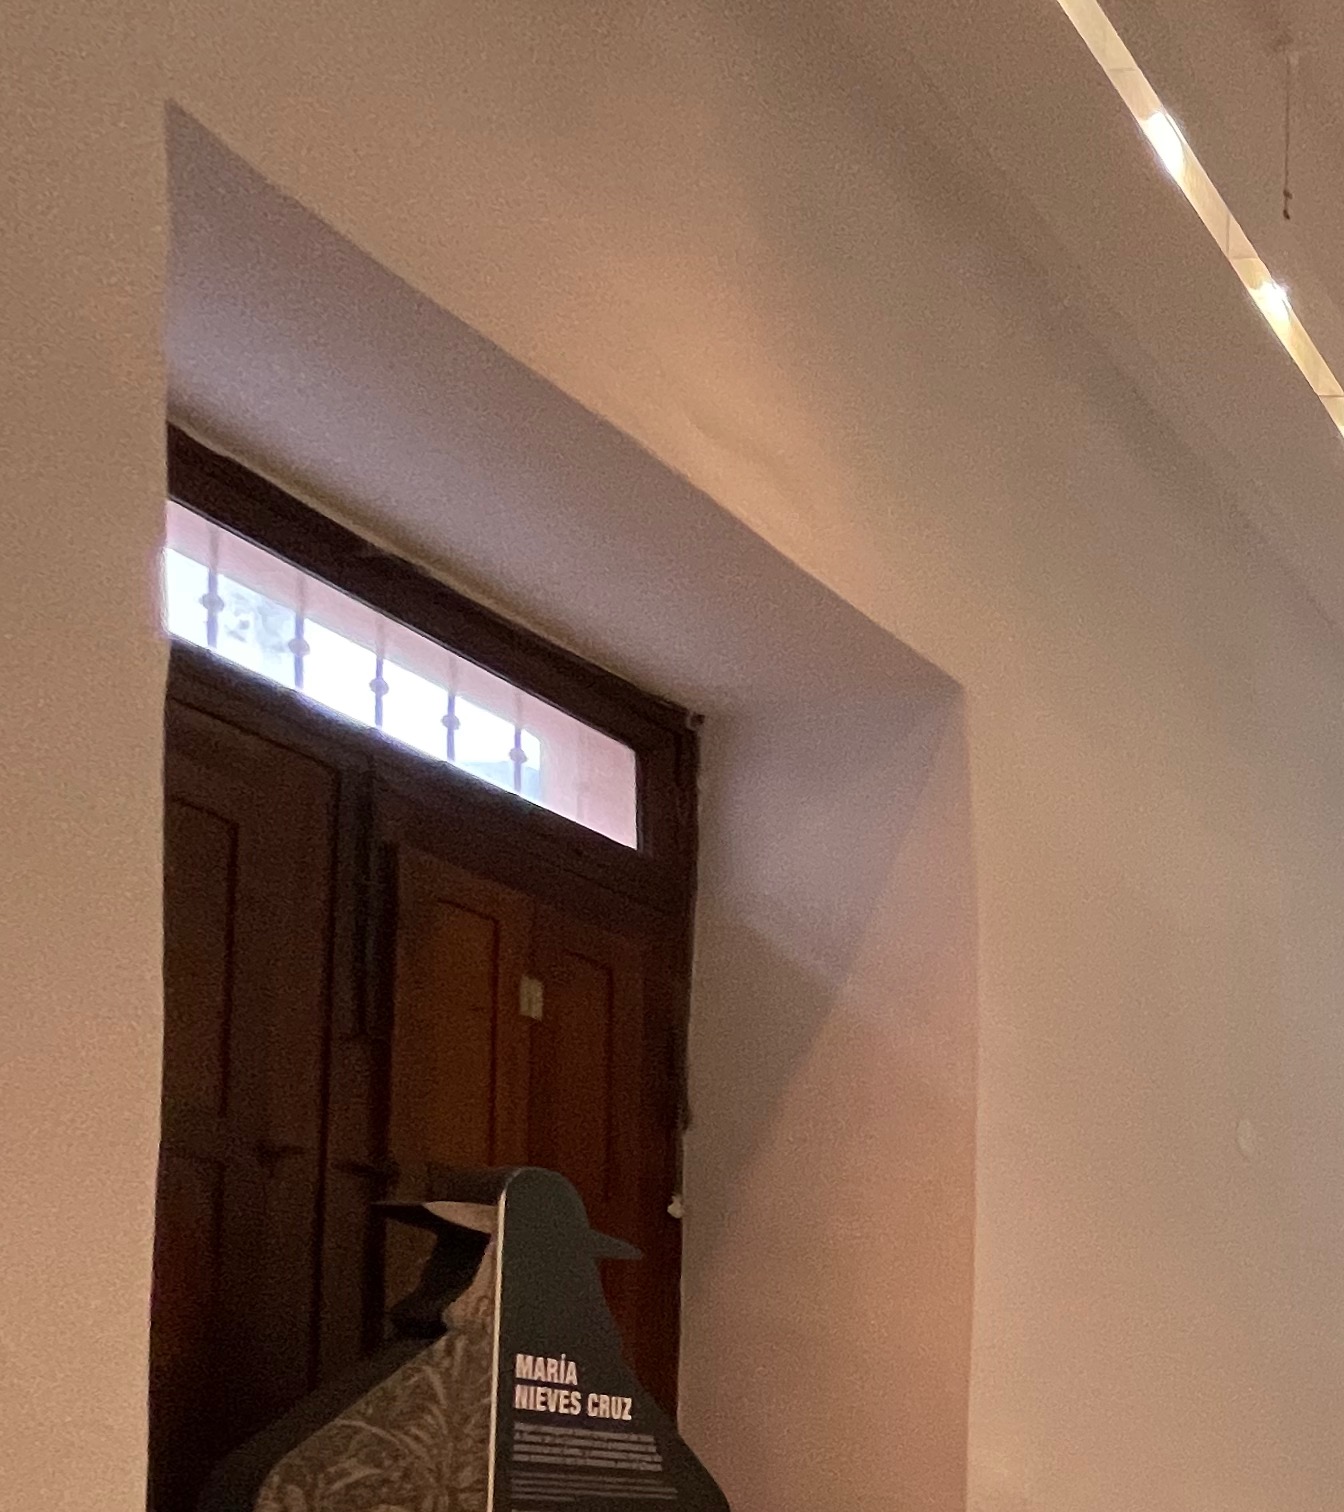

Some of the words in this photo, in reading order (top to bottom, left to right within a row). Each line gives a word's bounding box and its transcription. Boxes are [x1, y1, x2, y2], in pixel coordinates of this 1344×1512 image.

[515, 1353, 578, 1386] MARÍA
[514, 1384, 582, 1416] NIEVES
[587, 1393, 633, 1421] CRUZ
